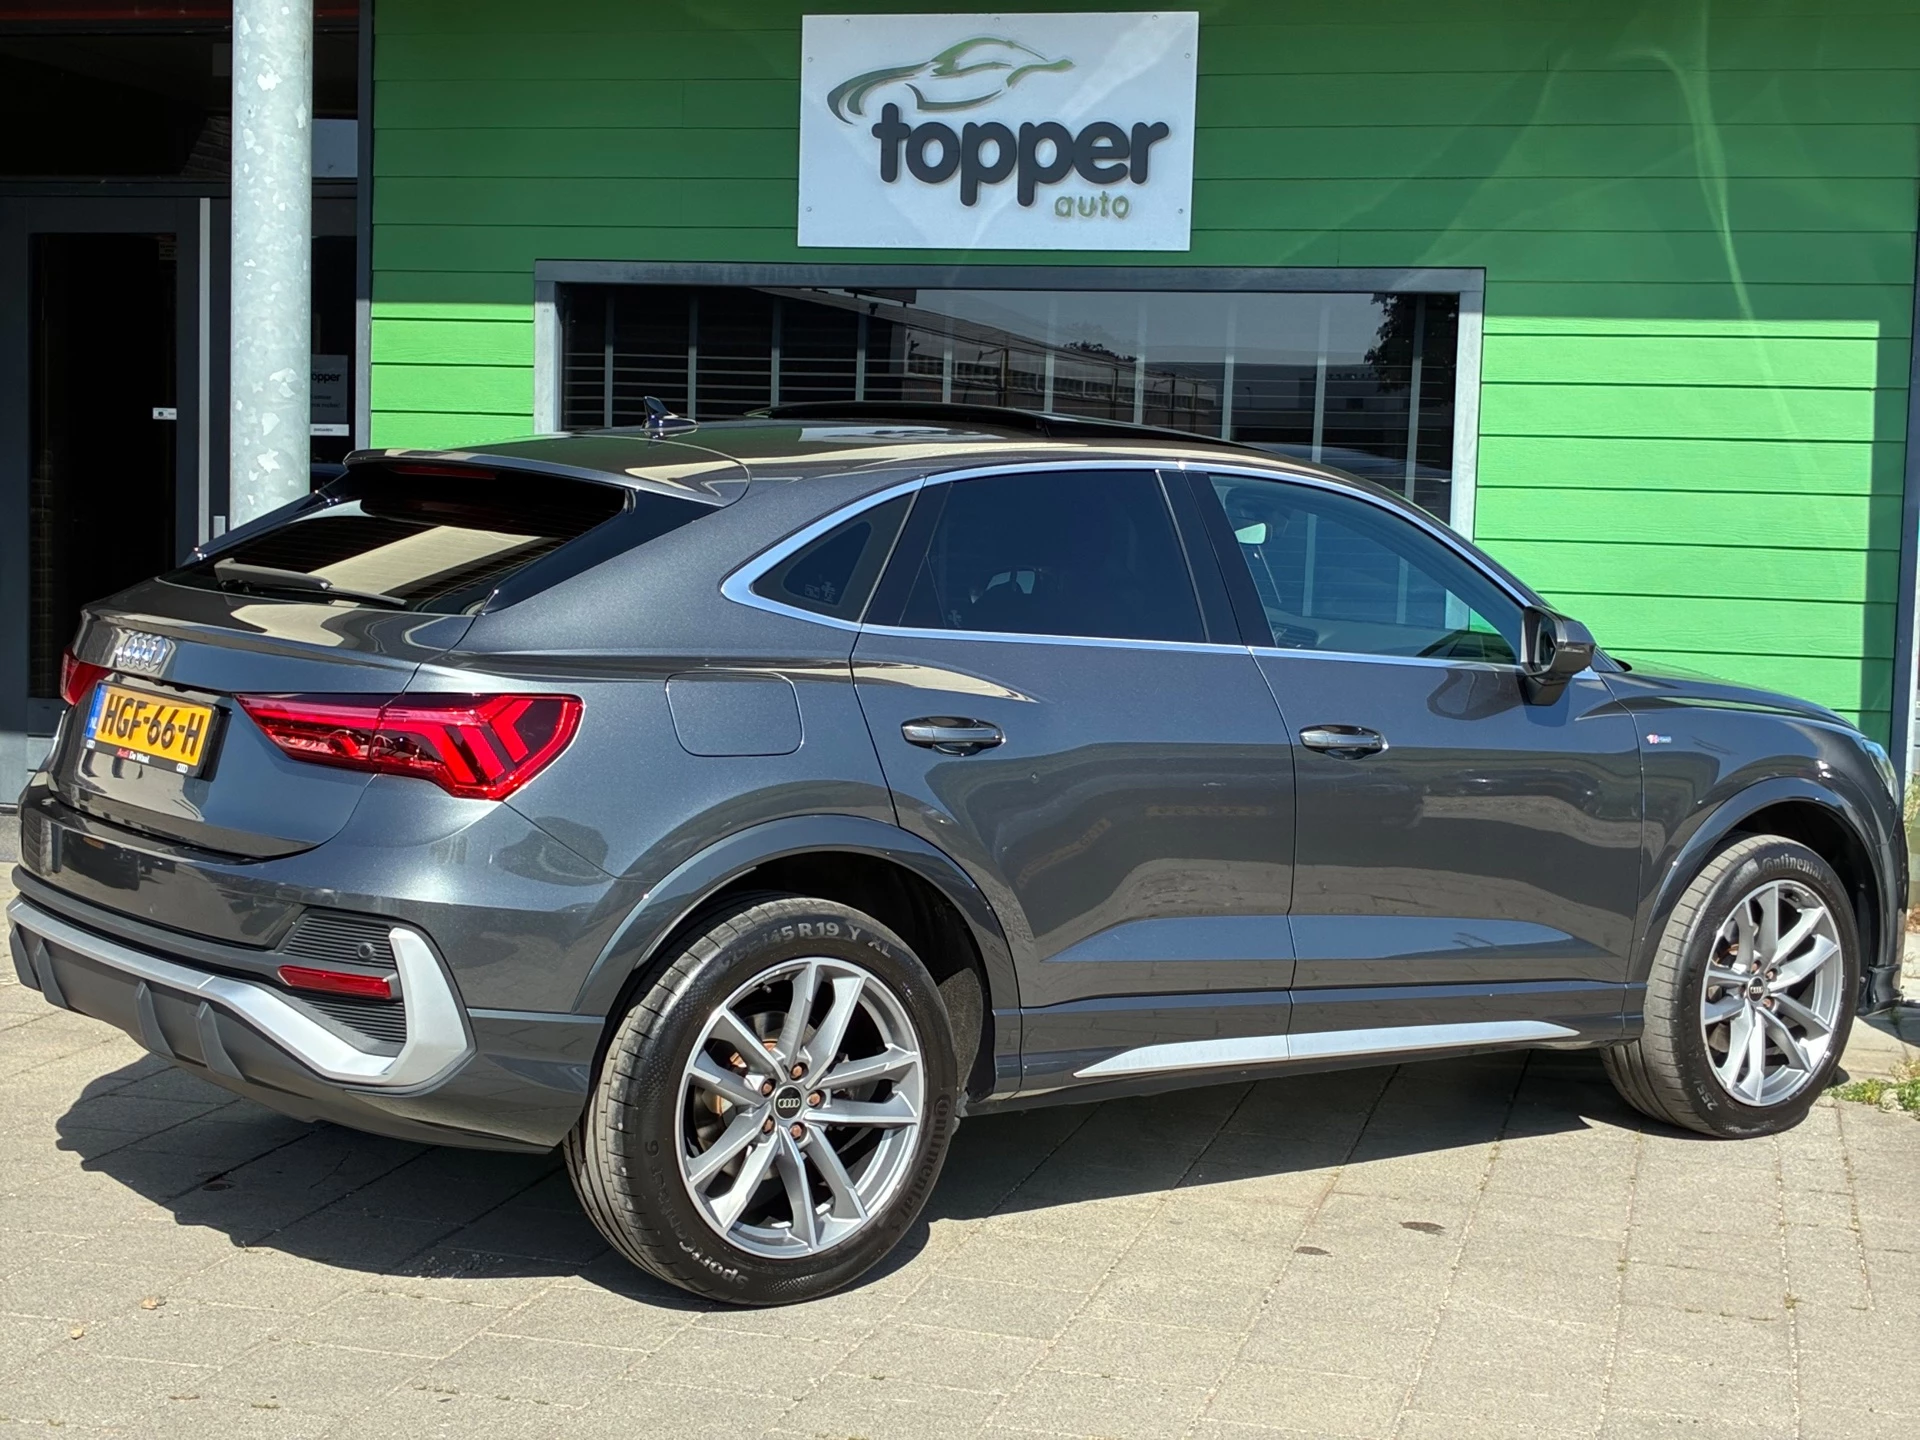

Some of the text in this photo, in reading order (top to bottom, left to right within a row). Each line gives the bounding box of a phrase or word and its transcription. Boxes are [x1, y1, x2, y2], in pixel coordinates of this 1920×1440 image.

[871, 102, 1170, 207] topper
[1054, 191, 1130, 219] auto
[101, 693, 204, 757] HGF-66-H
[1762, 852, 1824, 881] Continental
[847, 924, 862, 941] Y
[867, 936, 892, 958] XL
[900, 1093, 952, 1221] Continental
